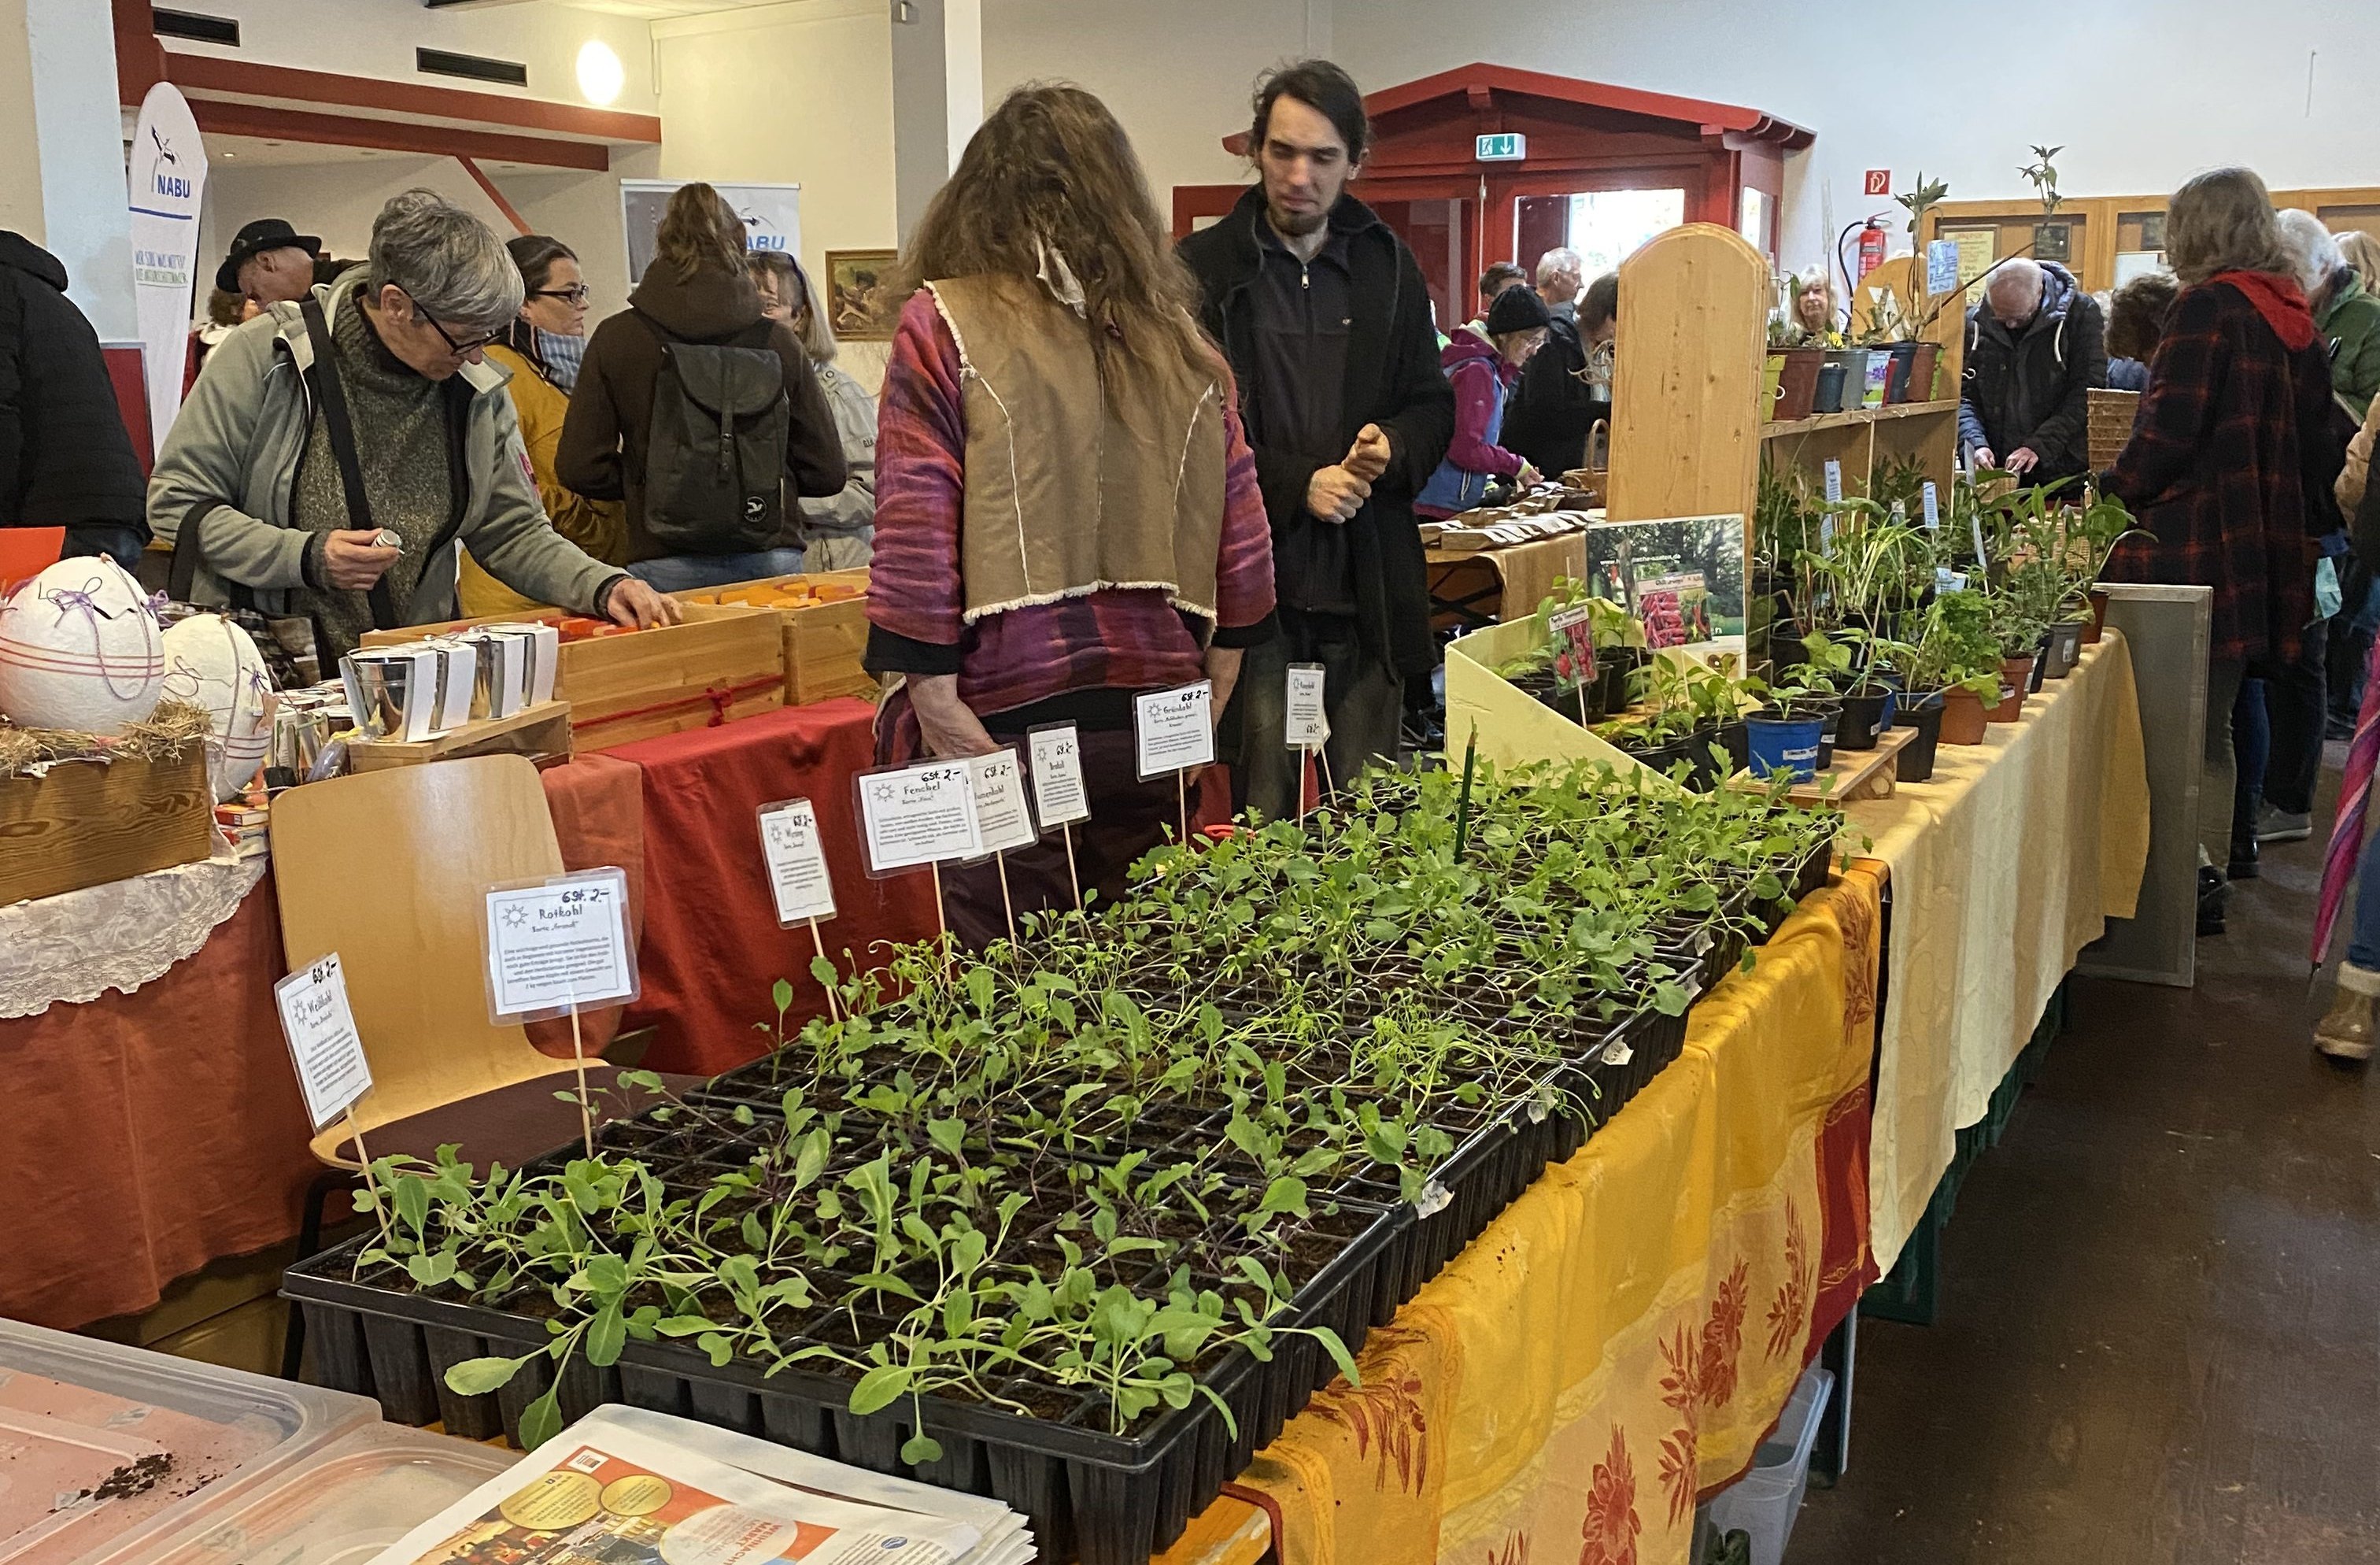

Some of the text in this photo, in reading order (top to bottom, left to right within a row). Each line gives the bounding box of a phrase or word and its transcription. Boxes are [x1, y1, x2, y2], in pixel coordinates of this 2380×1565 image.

[157, 174, 190, 198] NABU
[747, 235, 785, 250] ABU
[904, 781, 941, 795] Fenchel
[539, 904, 583, 920] Rotkohl
[735, 1521, 773, 1547] MARKT
